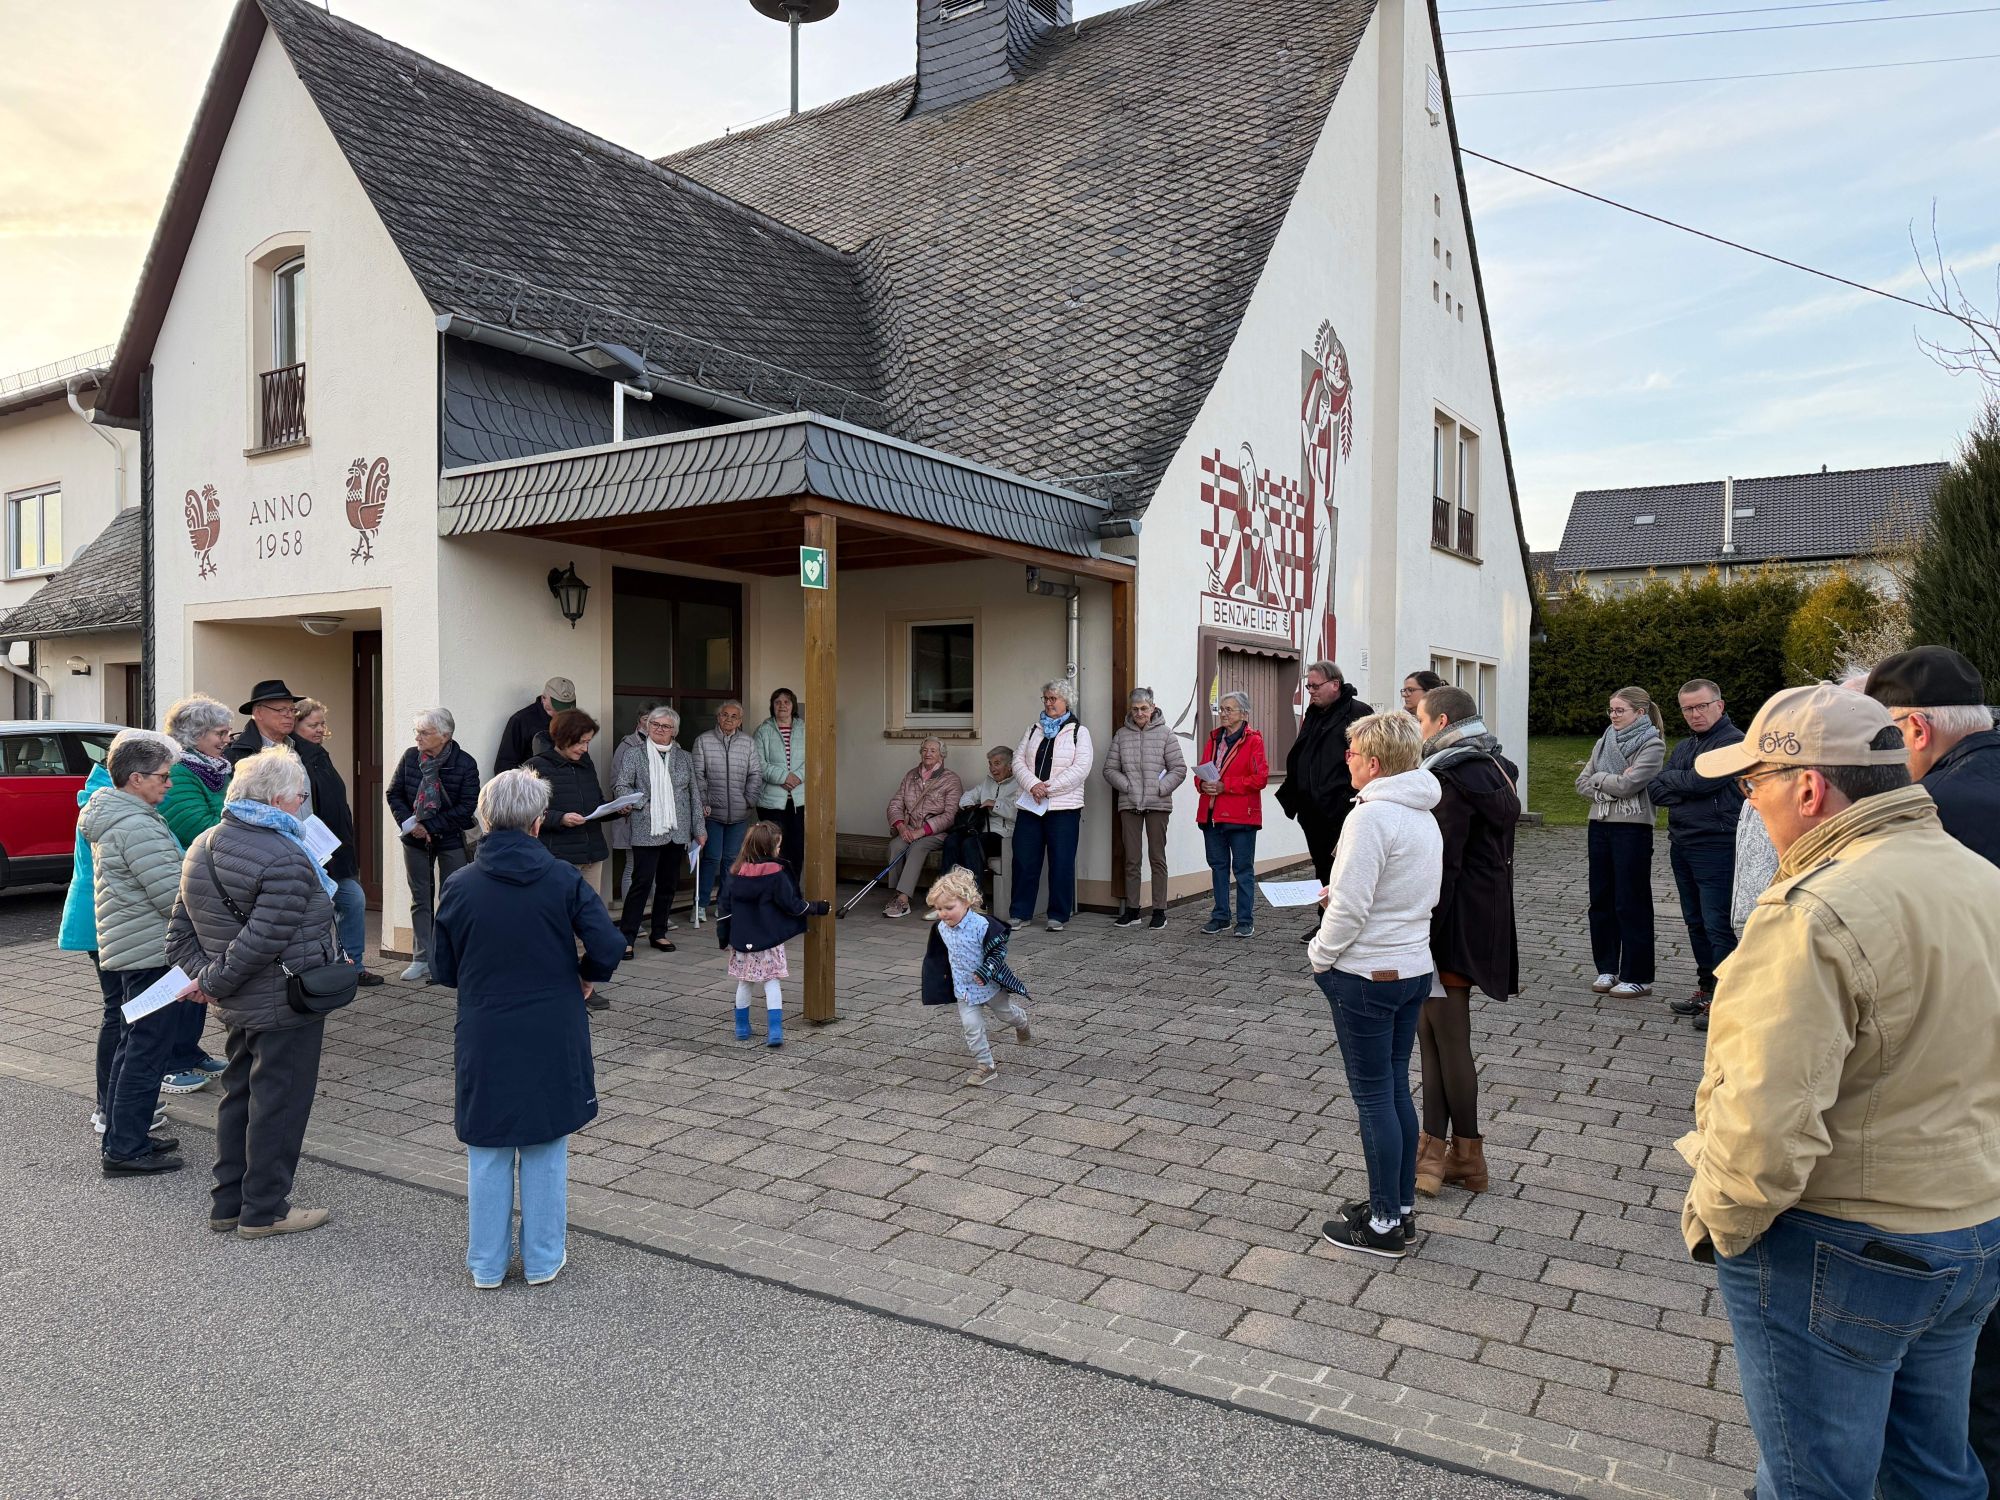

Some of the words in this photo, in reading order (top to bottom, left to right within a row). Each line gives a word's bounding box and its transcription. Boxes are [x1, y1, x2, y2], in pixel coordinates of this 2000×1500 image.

[249, 492, 312, 526] ANNO
[256, 529, 303, 560] 1958
[1213, 600, 1278, 632] BENZWEILER
[1350, 1230, 1369, 1246] N
